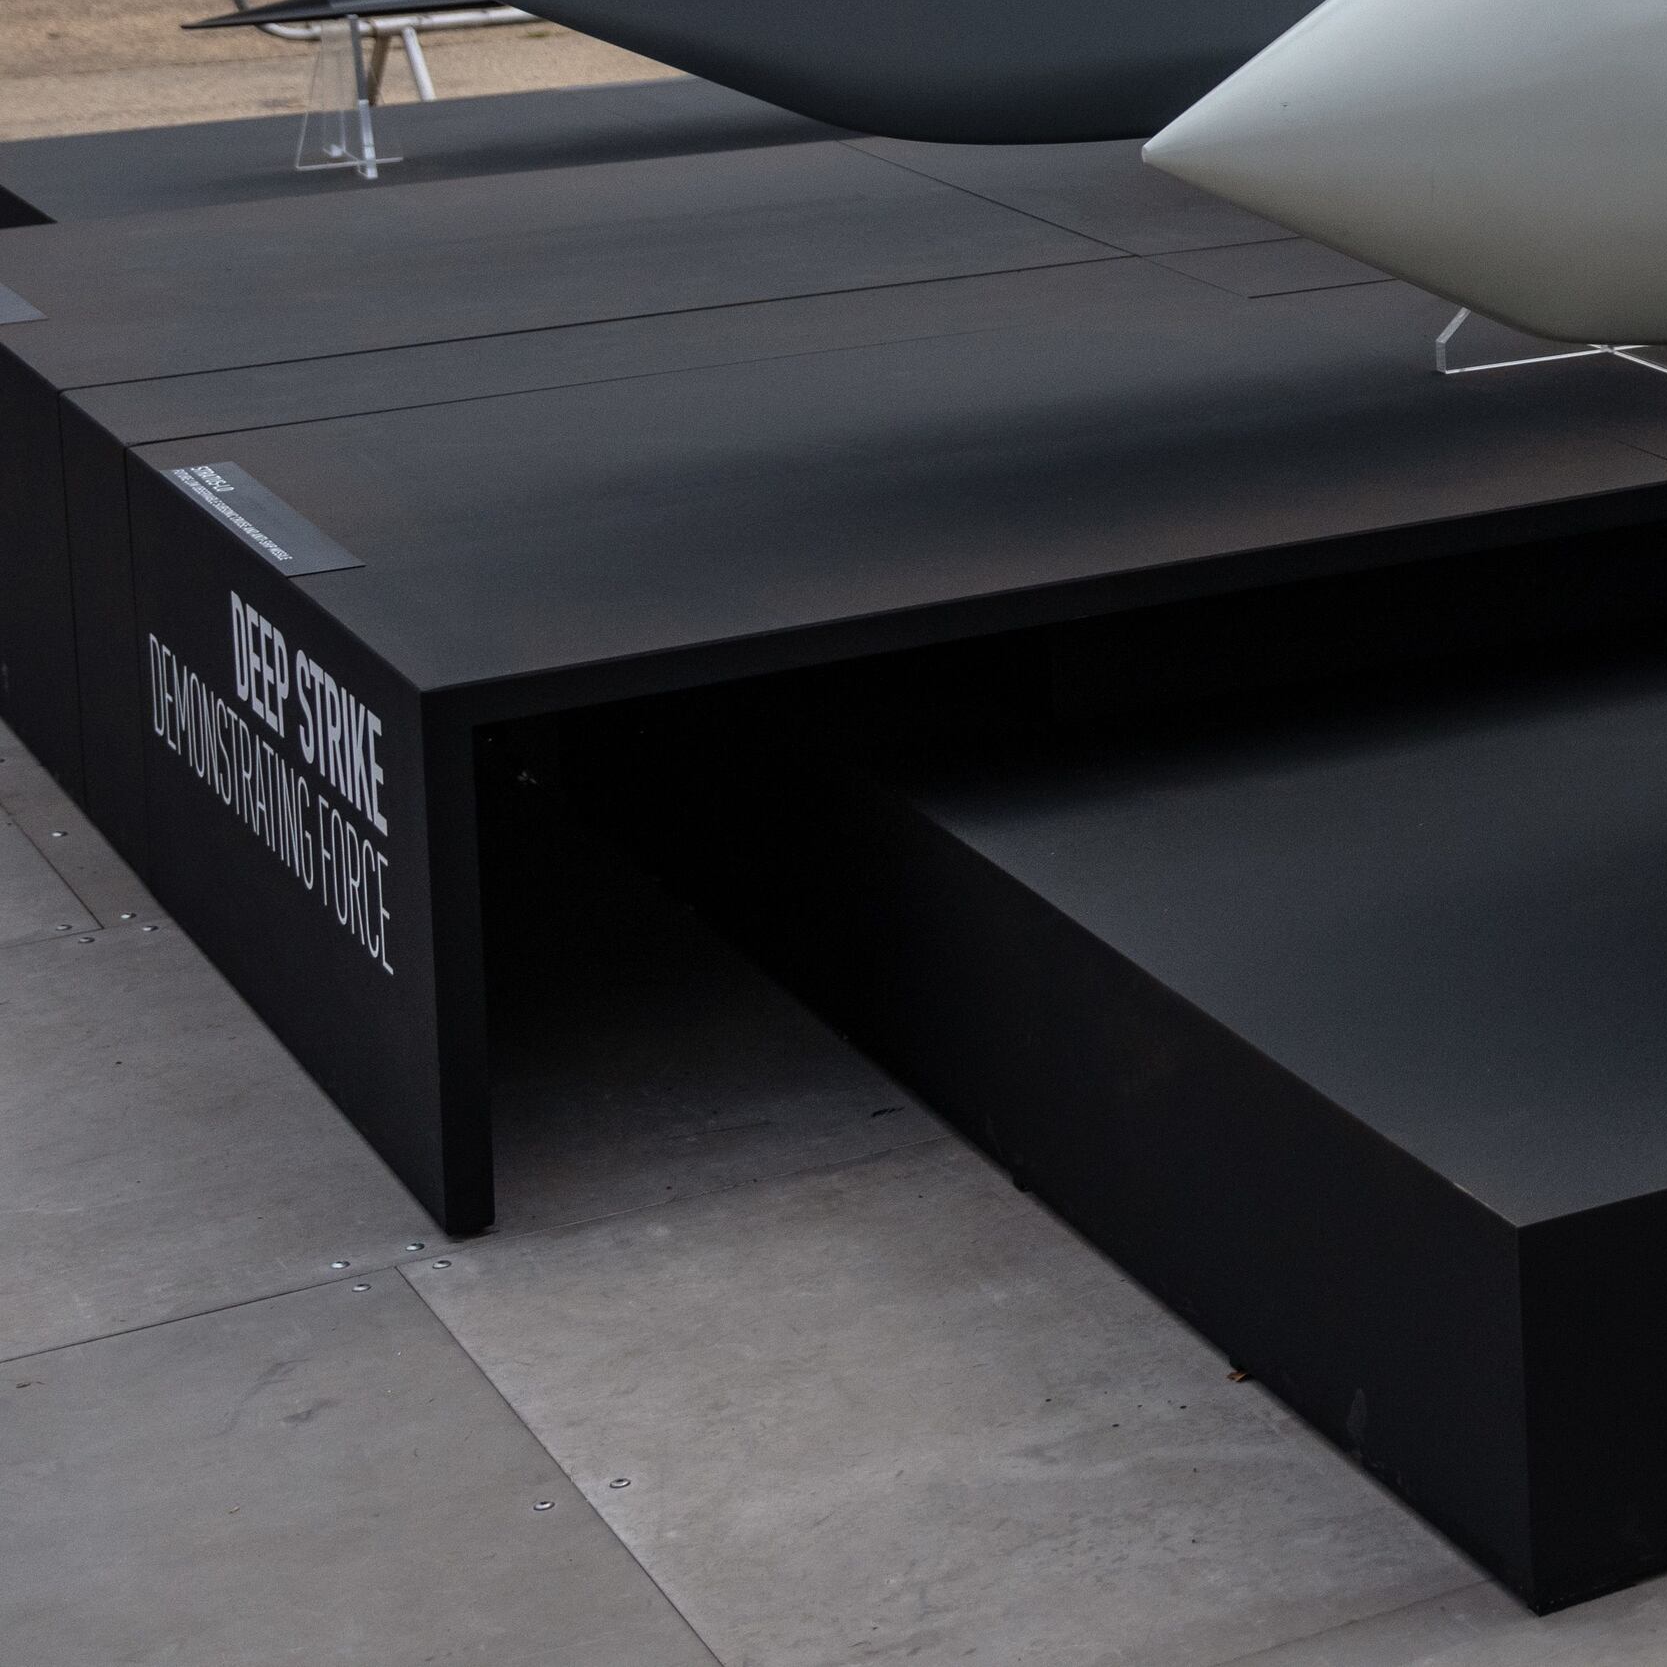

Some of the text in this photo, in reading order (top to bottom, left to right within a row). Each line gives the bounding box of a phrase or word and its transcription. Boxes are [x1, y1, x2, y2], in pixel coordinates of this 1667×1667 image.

[149, 632, 394, 976] DEMONSTRATING FORCE
[230, 590, 388, 837] DEEP STRIKE
